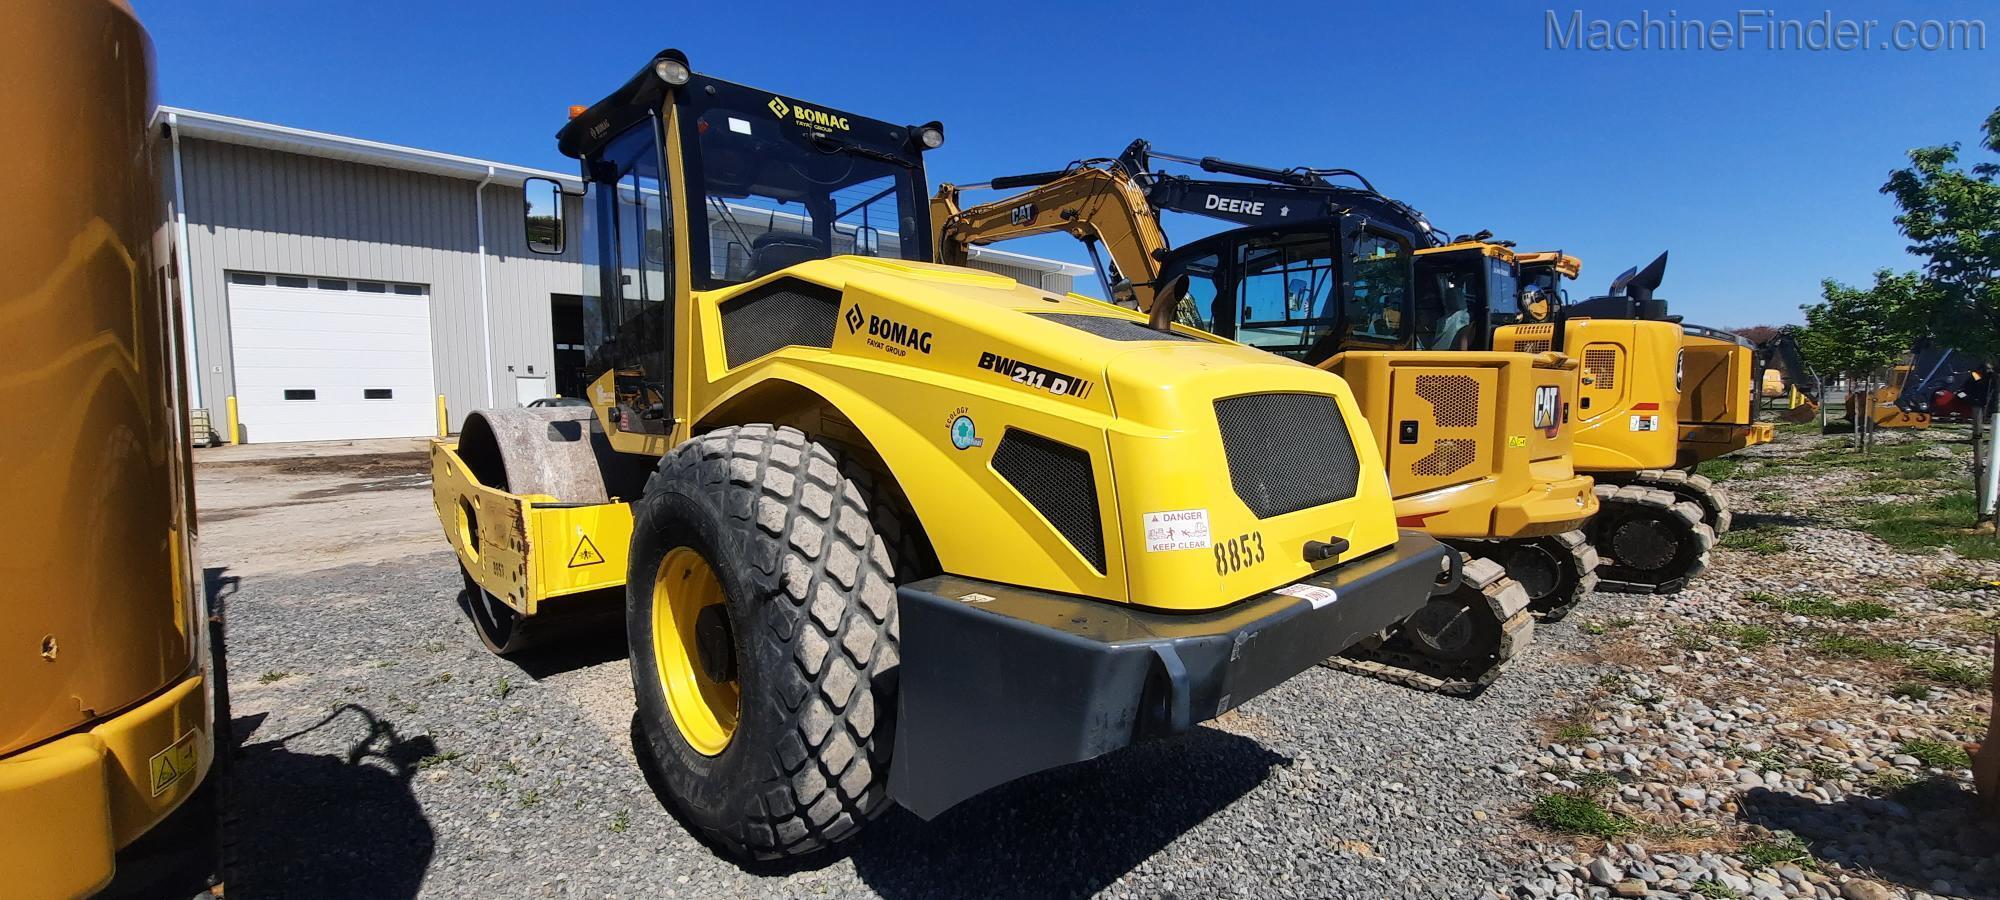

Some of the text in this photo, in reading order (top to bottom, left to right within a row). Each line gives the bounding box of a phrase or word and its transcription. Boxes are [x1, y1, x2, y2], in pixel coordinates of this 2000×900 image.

[793, 105, 850, 131] BOMAG
[1011, 203, 1033, 225] CAT
[1205, 194, 1265, 216] DEERE
[869, 314, 933, 354] BOMAG
[867, 338, 906, 357] FAYAT GROUP
[1048, 377, 1068, 395] D
[945, 406, 969, 428] ECOLOGY
[1535, 387, 1558, 428] CAT
[1163, 511, 1202, 522] DANGER
[1153, 541, 1206, 552] KEEP CLEAR
[1213, 530, 1265, 577] 8853
